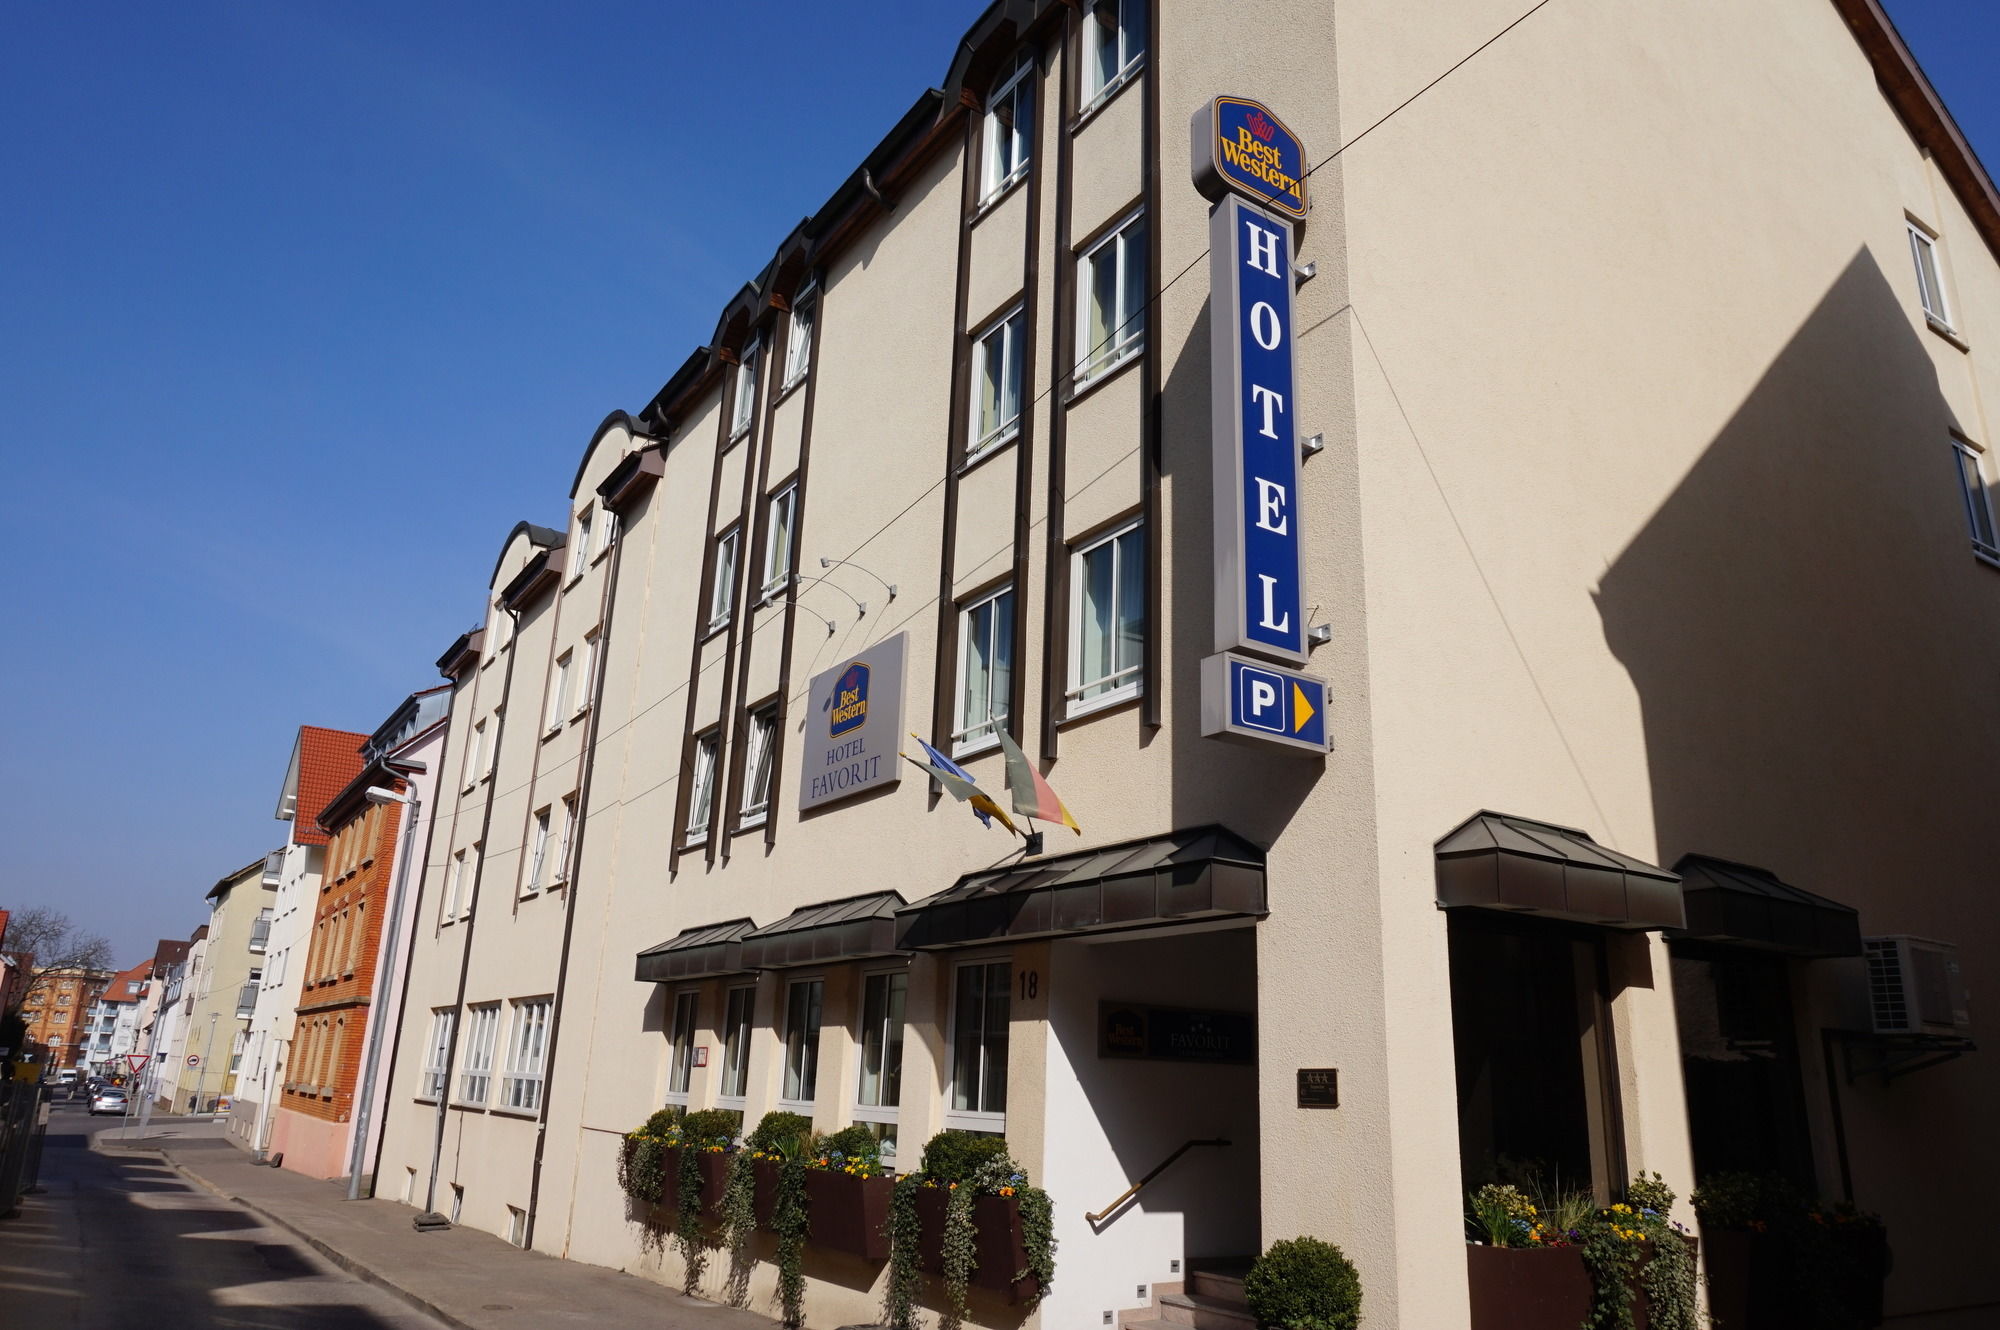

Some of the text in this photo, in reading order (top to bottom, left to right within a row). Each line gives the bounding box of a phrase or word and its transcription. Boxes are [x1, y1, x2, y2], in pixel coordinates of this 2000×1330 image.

[1237, 126, 1282, 169] Best
[1221, 136, 1302, 200] Western
[1245, 220, 1289, 634] HOTEL
[839, 683, 860, 709] Best
[1252, 679, 1276, 717] P
[831, 700, 866, 727] Western
[826, 738, 866, 766] HOTEL
[811, 755, 881, 799] FAVORIT
[1020, 970, 1038, 1000] 18
[1170, 1033, 1232, 1049] FAVORIT
